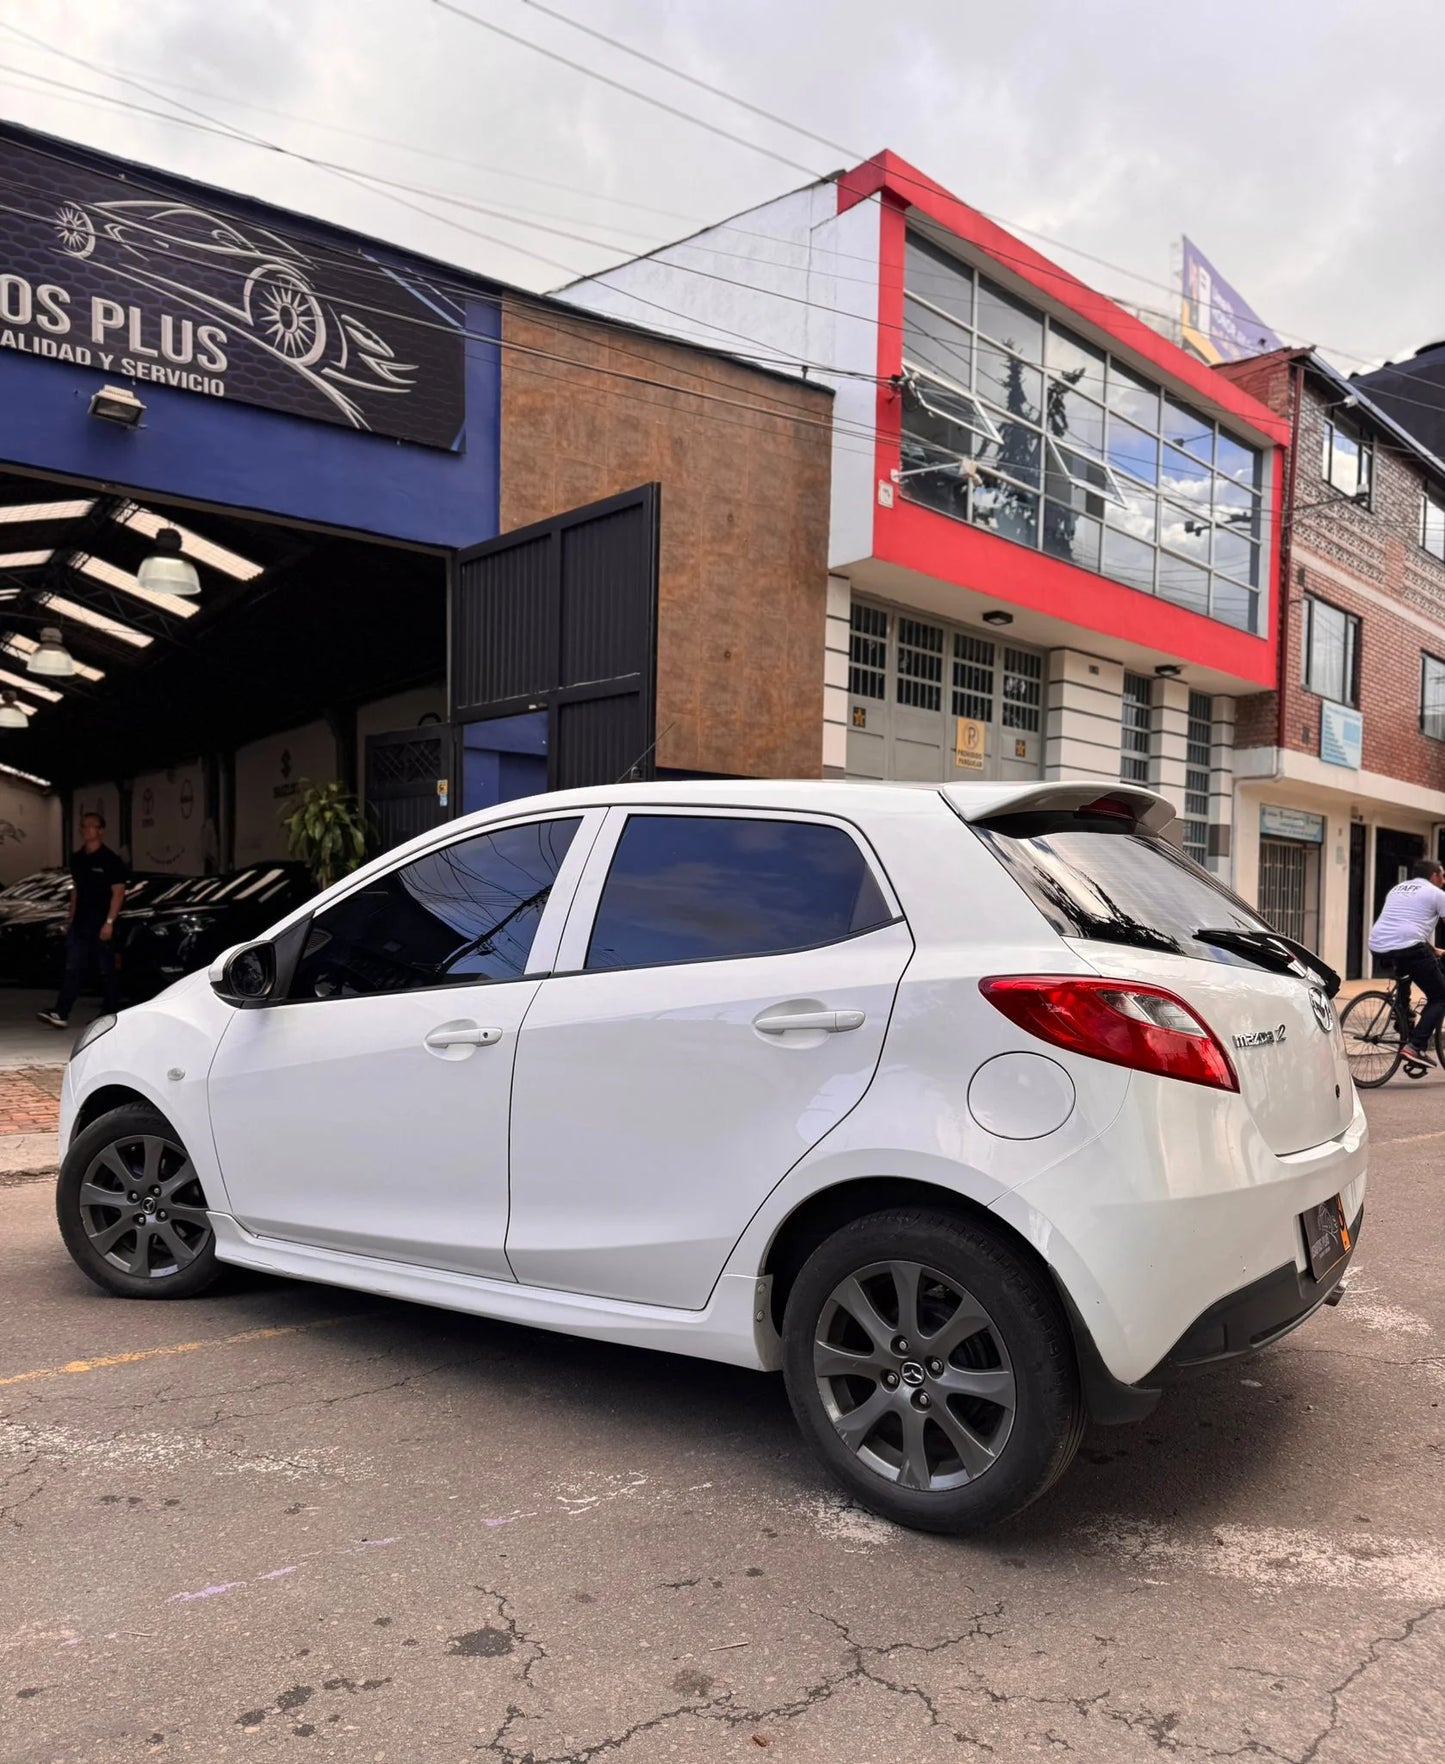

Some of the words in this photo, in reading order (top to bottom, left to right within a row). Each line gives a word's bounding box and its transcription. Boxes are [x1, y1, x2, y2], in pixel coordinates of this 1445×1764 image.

[0, 273, 71, 335] OS
[91, 295, 228, 373] PLUS
[0, 329, 91, 366] ALIDAD
[98, 352, 114, 371] Y
[121, 358, 225, 397] SERVICIO
